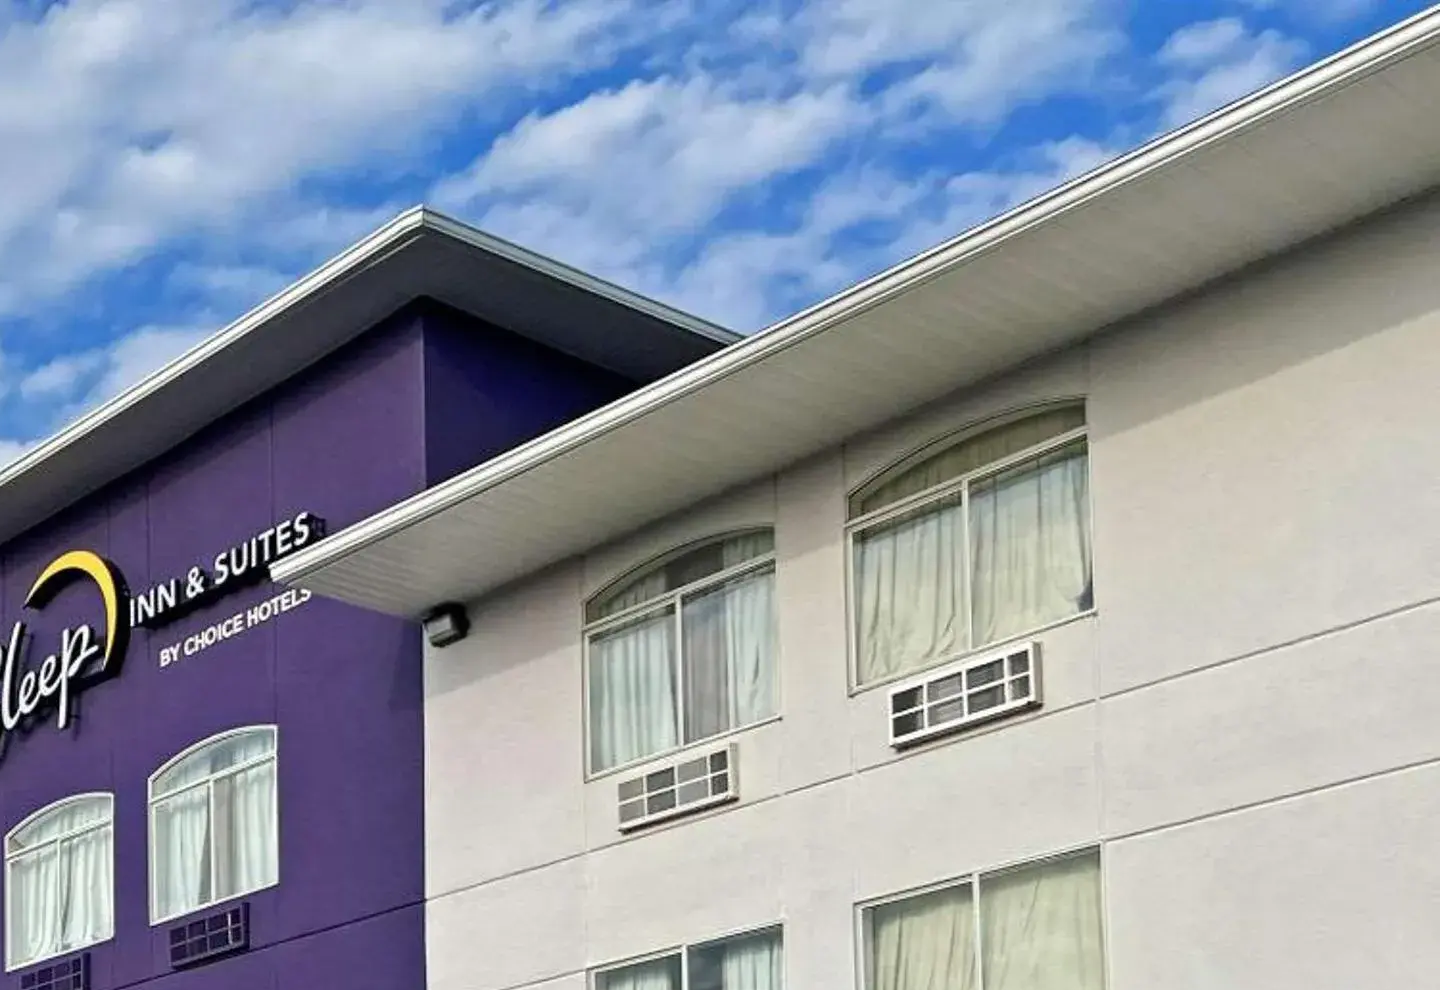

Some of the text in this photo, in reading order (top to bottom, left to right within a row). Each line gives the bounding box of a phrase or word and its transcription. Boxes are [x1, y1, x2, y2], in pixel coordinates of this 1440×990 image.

[129, 512, 310, 627] INN & SUITES
[160, 588, 312, 668] BY CHOICE HOTELS
